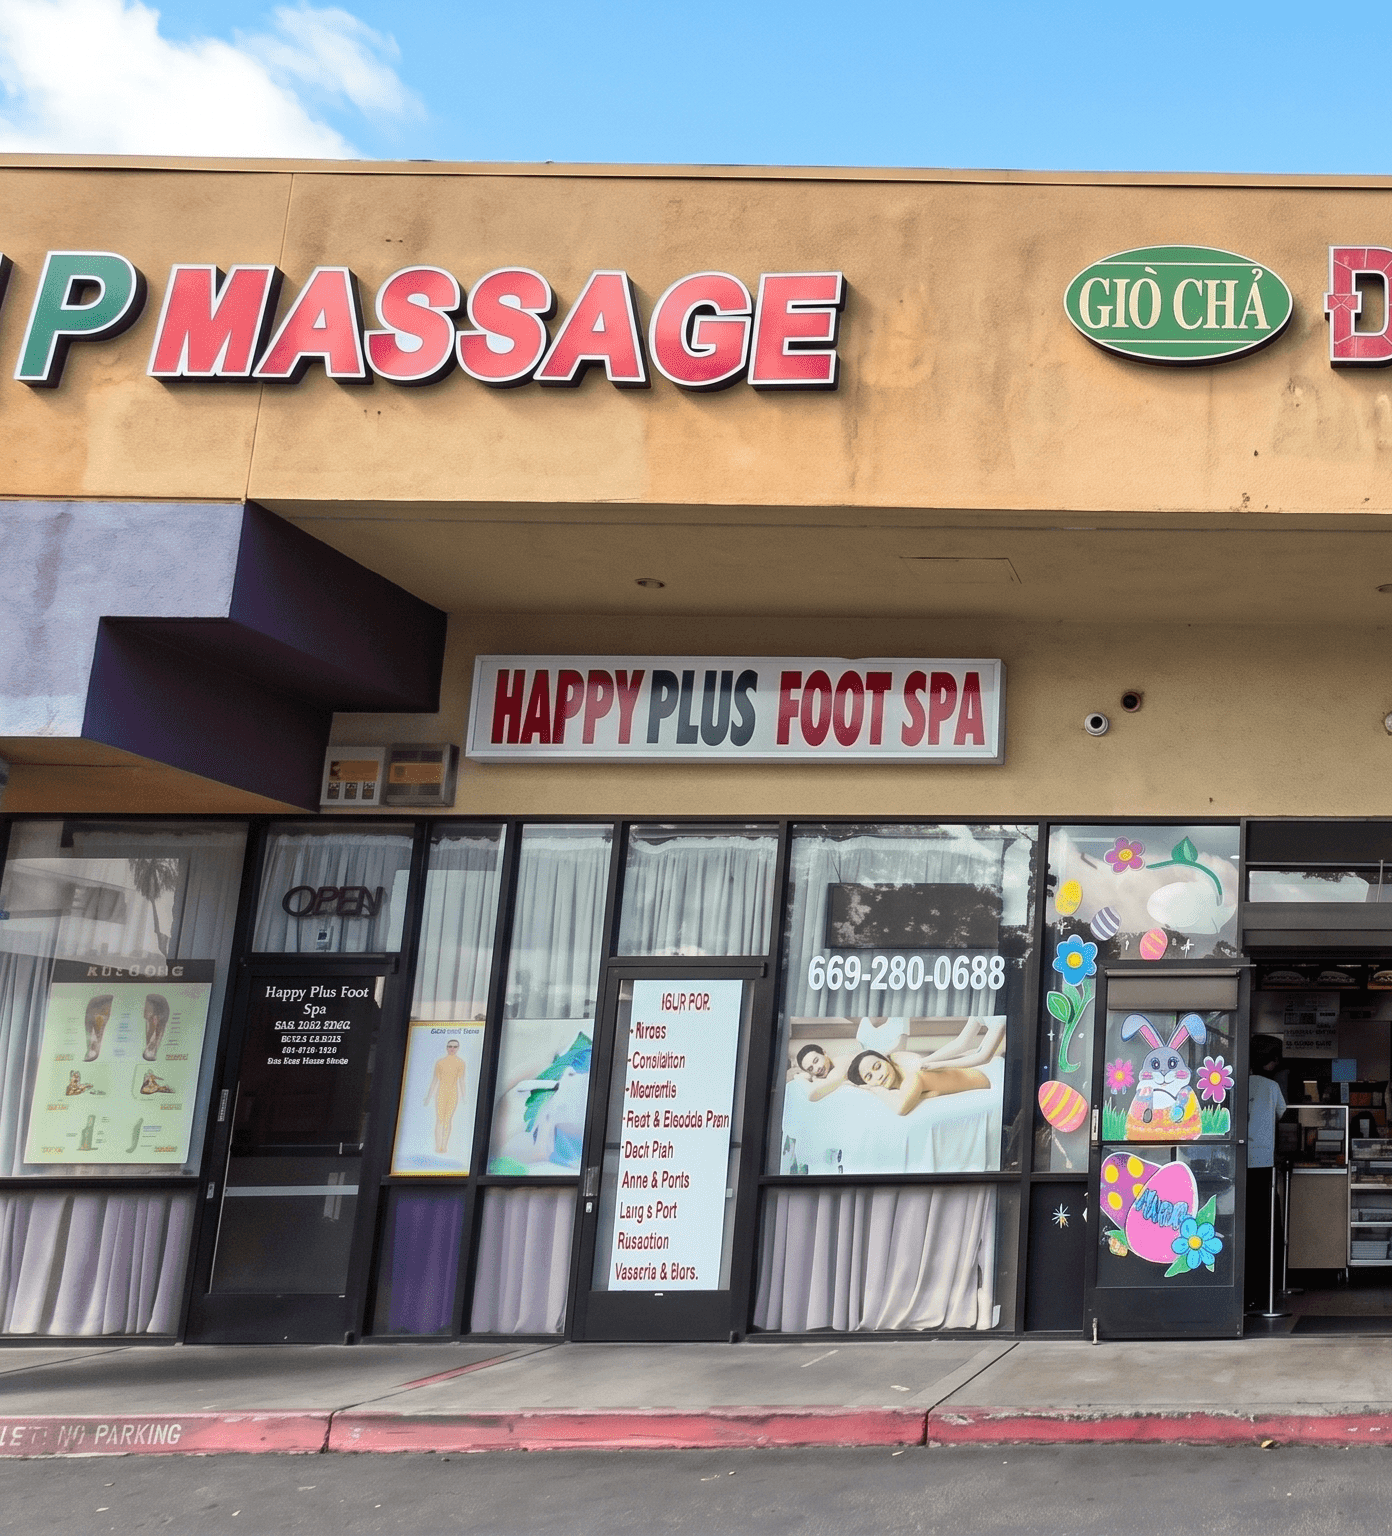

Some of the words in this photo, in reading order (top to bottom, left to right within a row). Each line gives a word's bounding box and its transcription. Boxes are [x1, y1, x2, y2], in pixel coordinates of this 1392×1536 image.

[1079, 266, 1162, 330] GIÒ
[1172, 268, 1271, 330] CHẢ
[14, 250, 141, 386] P
[146, 264, 844, 392] MASSAGE
[491, 669, 645, 745] HAPPY
[646, 669, 758, 747] PLUS
[776, 671, 892, 747] FOOT
[901, 671, 986, 747] SPA
[281, 885, 384, 918] OPEN
[807, 955, 1006, 990] 669-280-0688
[265, 986, 306, 1001] Happy
[310, 985, 336, 998] Plus
[341, 986, 369, 998] Foot
[303, 1003, 327, 1018] Spa
[655, 1201, 678, 1218] Port
[94, 1423, 182, 1445] PARKING
